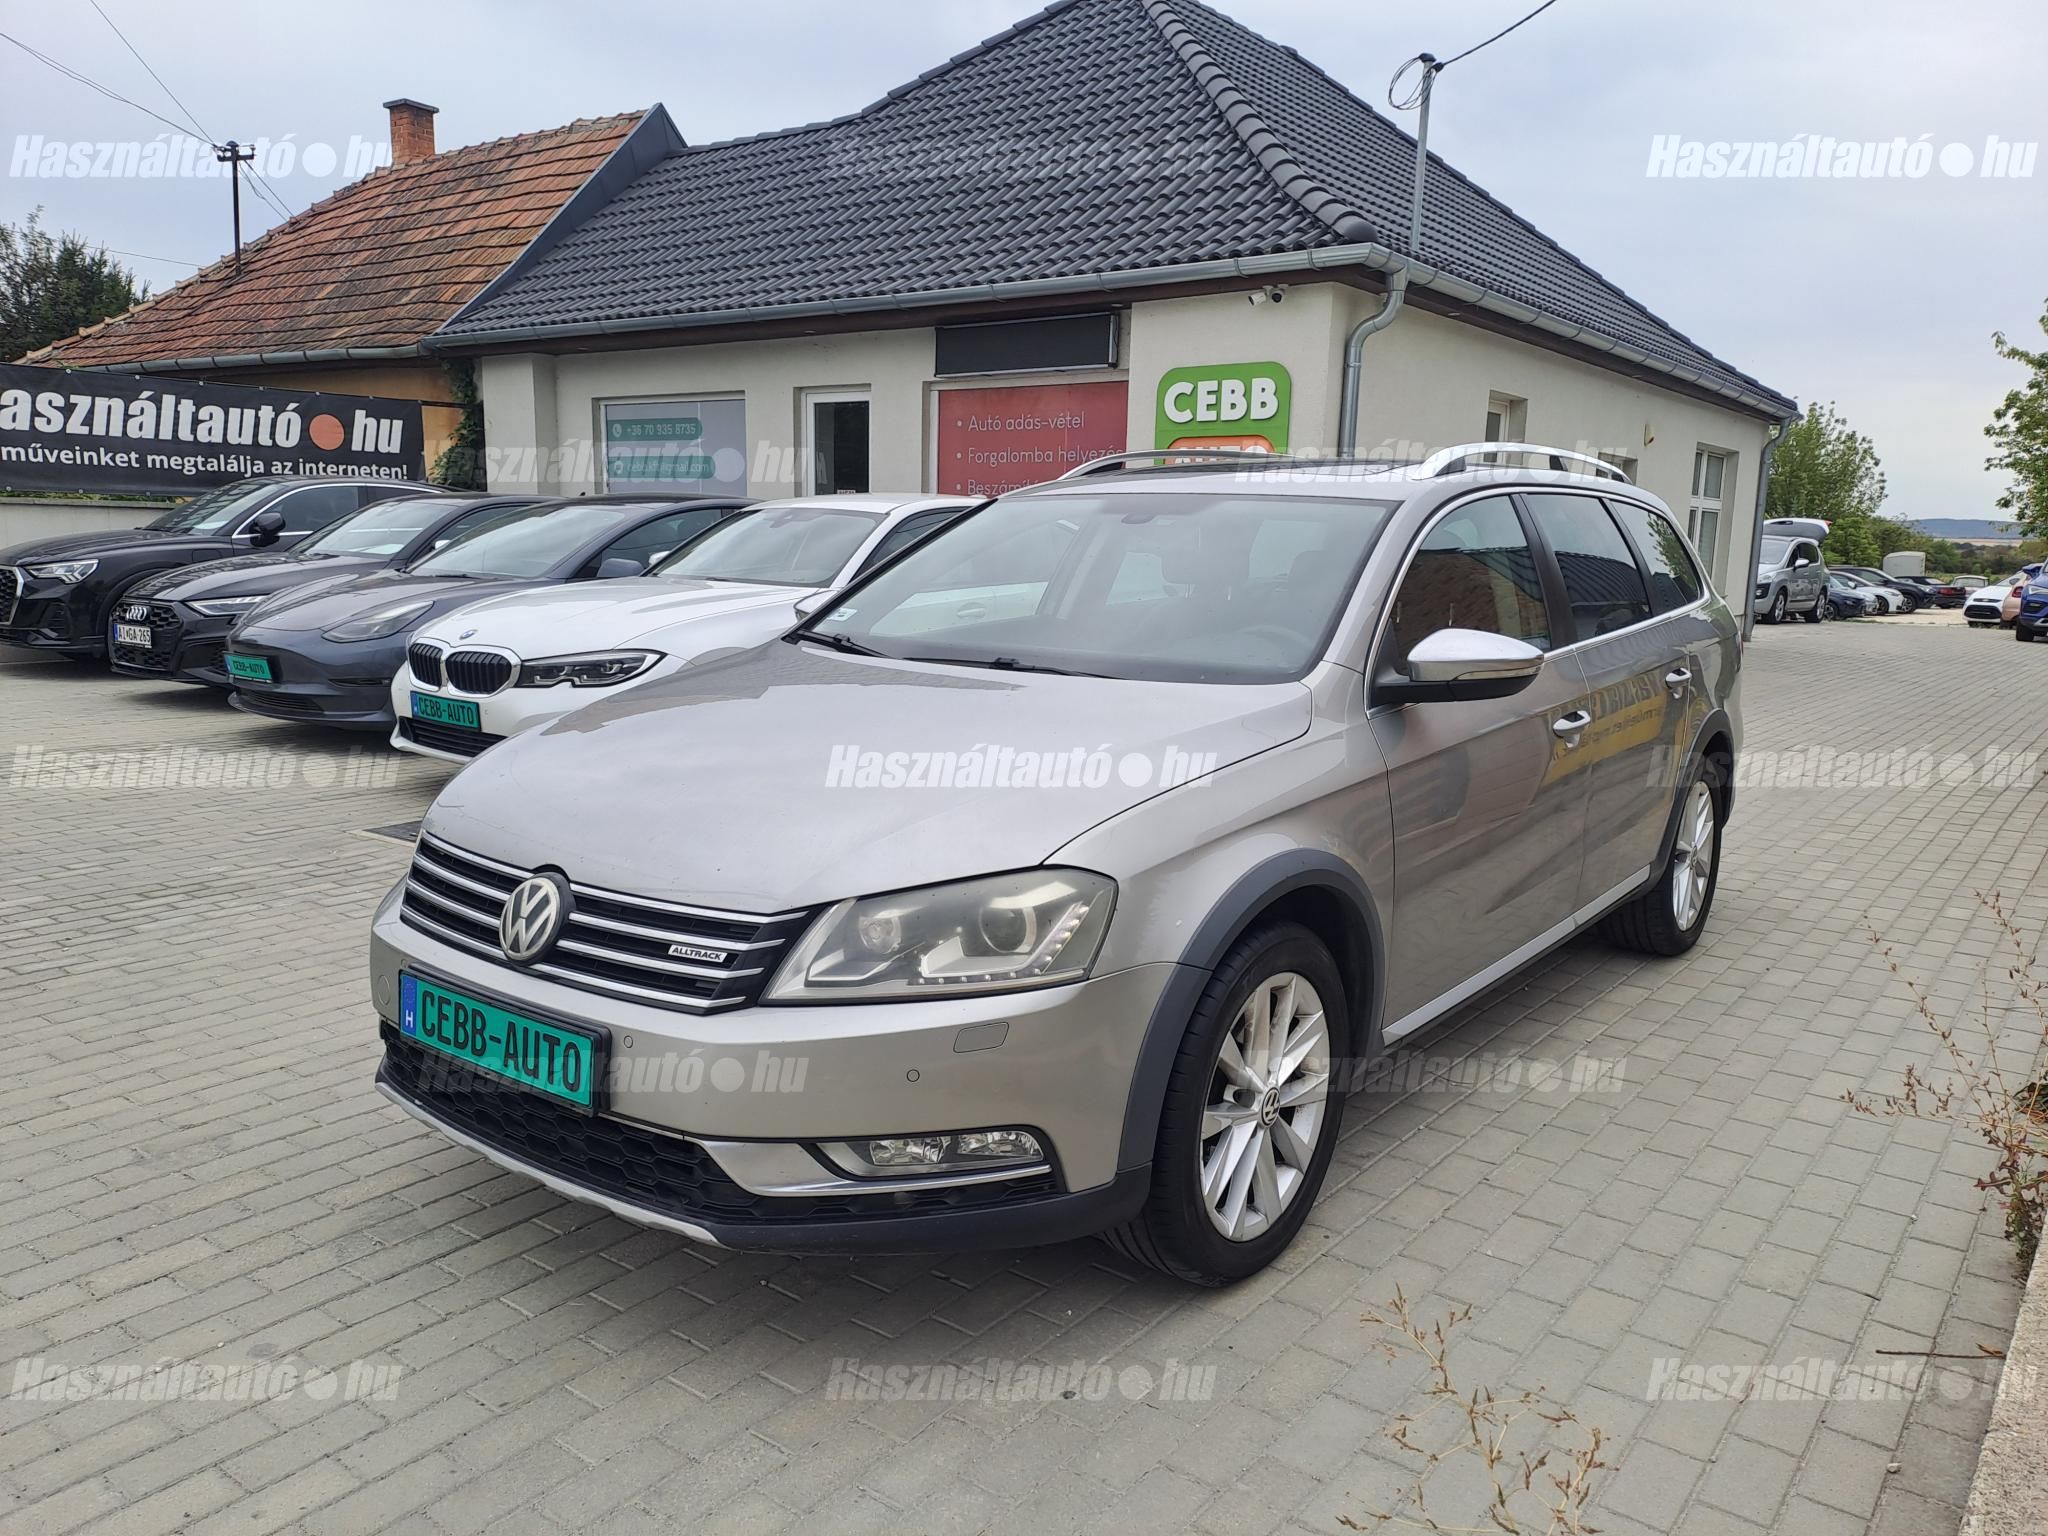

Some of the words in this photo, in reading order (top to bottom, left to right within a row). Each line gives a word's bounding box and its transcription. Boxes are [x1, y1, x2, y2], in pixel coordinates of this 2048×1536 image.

[1164, 377, 1279, 424] CEBB
[351, 409, 404, 454] hu
[627, 424, 642, 436] +36
[644, 424, 654, 436] 70
[657, 423, 673, 435] 935
[676, 423, 696, 435] 8735
[968, 415, 1001, 431] Autó
[1006, 411, 1085, 430] adás-vétel
[1, 443, 139, 469] műveinket
[147, 452, 265, 478] megtalálja
[271, 460, 294, 475] az
[299, 458, 408, 480] interneten!
[968, 447, 1053, 467] Forgalomba
[418, 697, 475, 726] CEBB-AUTO
[671, 944, 724, 961] ALLTRACK
[405, 1010, 414, 1028] H
[420, 989, 582, 1093] CEBB-AUTO
